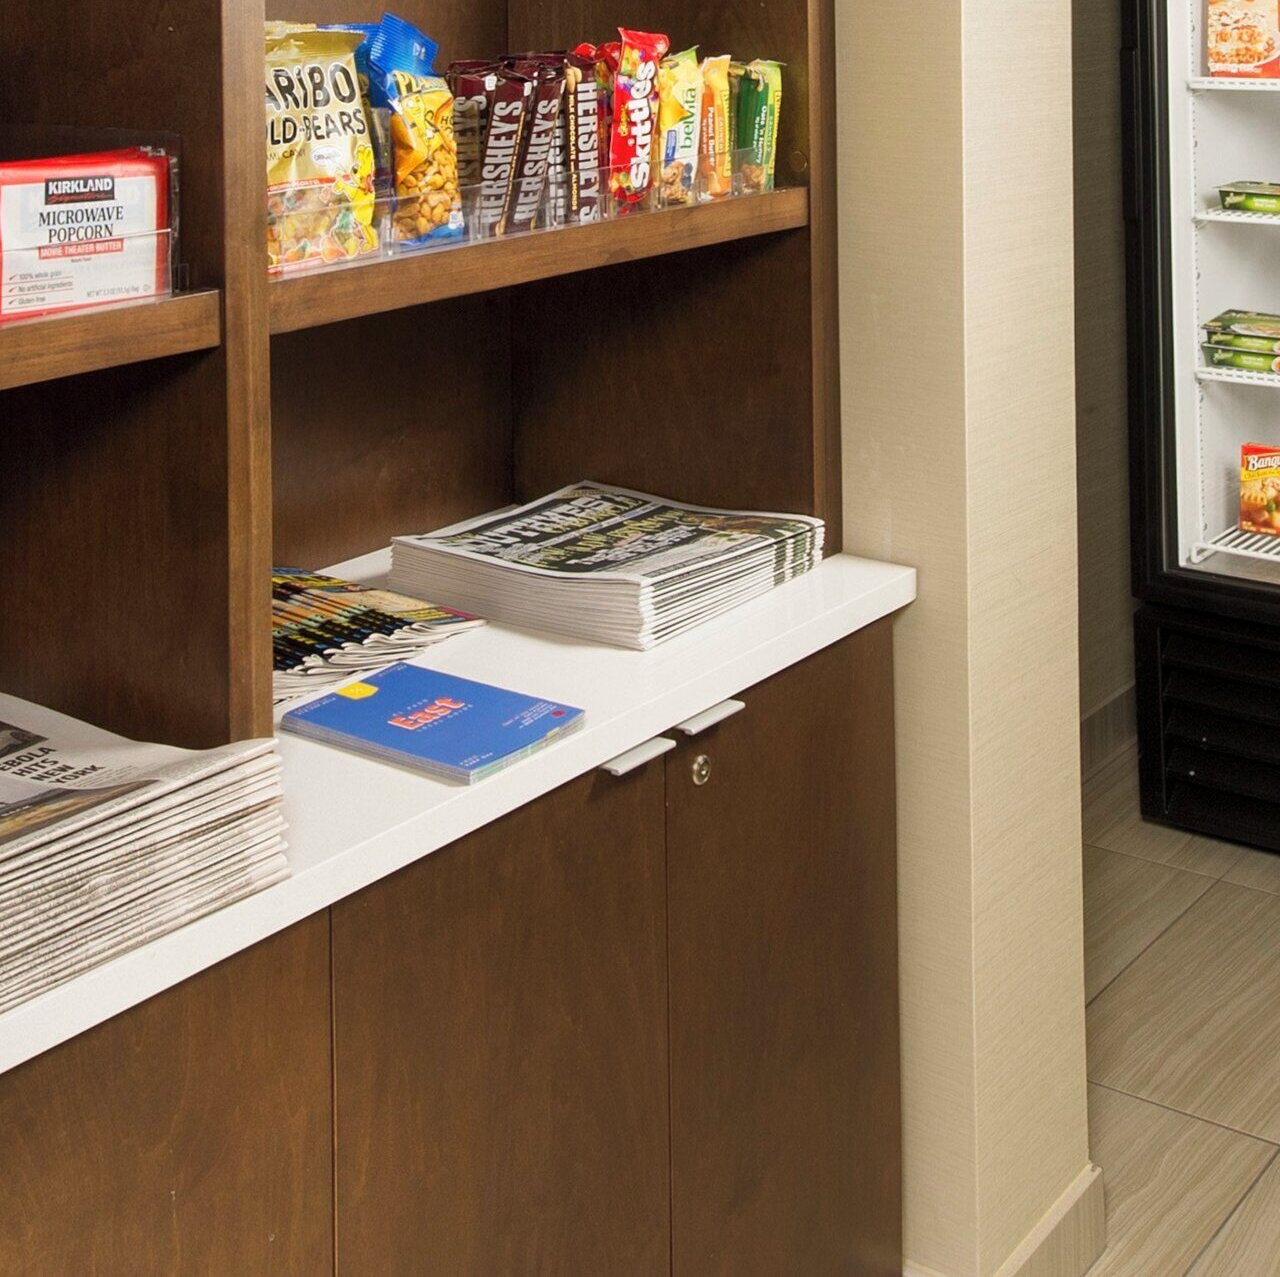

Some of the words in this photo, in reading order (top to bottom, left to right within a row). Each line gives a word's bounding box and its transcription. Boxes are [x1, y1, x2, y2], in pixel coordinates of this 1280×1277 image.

[265, 62, 357, 113] ARIBO
[630, 60, 656, 189] Skittles
[680, 87, 698, 151] belVita
[481, 100, 522, 223] HERSHEY'S
[514, 97, 559, 223] HERSHEY'S
[577, 81, 600, 225] HERSHEY'S
[47, 178, 114, 196] KIRKLAND
[38, 205, 124, 227] MICROWAVE
[48, 223, 114, 243] POPCORN
[40, 247, 63, 259] MOVIE
[64, 243, 95, 256] THEATER
[95, 240, 123, 253] BUTTER
[387, 696, 465, 730] East
[11, 758, 59, 777] HITS
[30, 764, 75, 783] NEW
[50, 764, 105, 785] YORK
